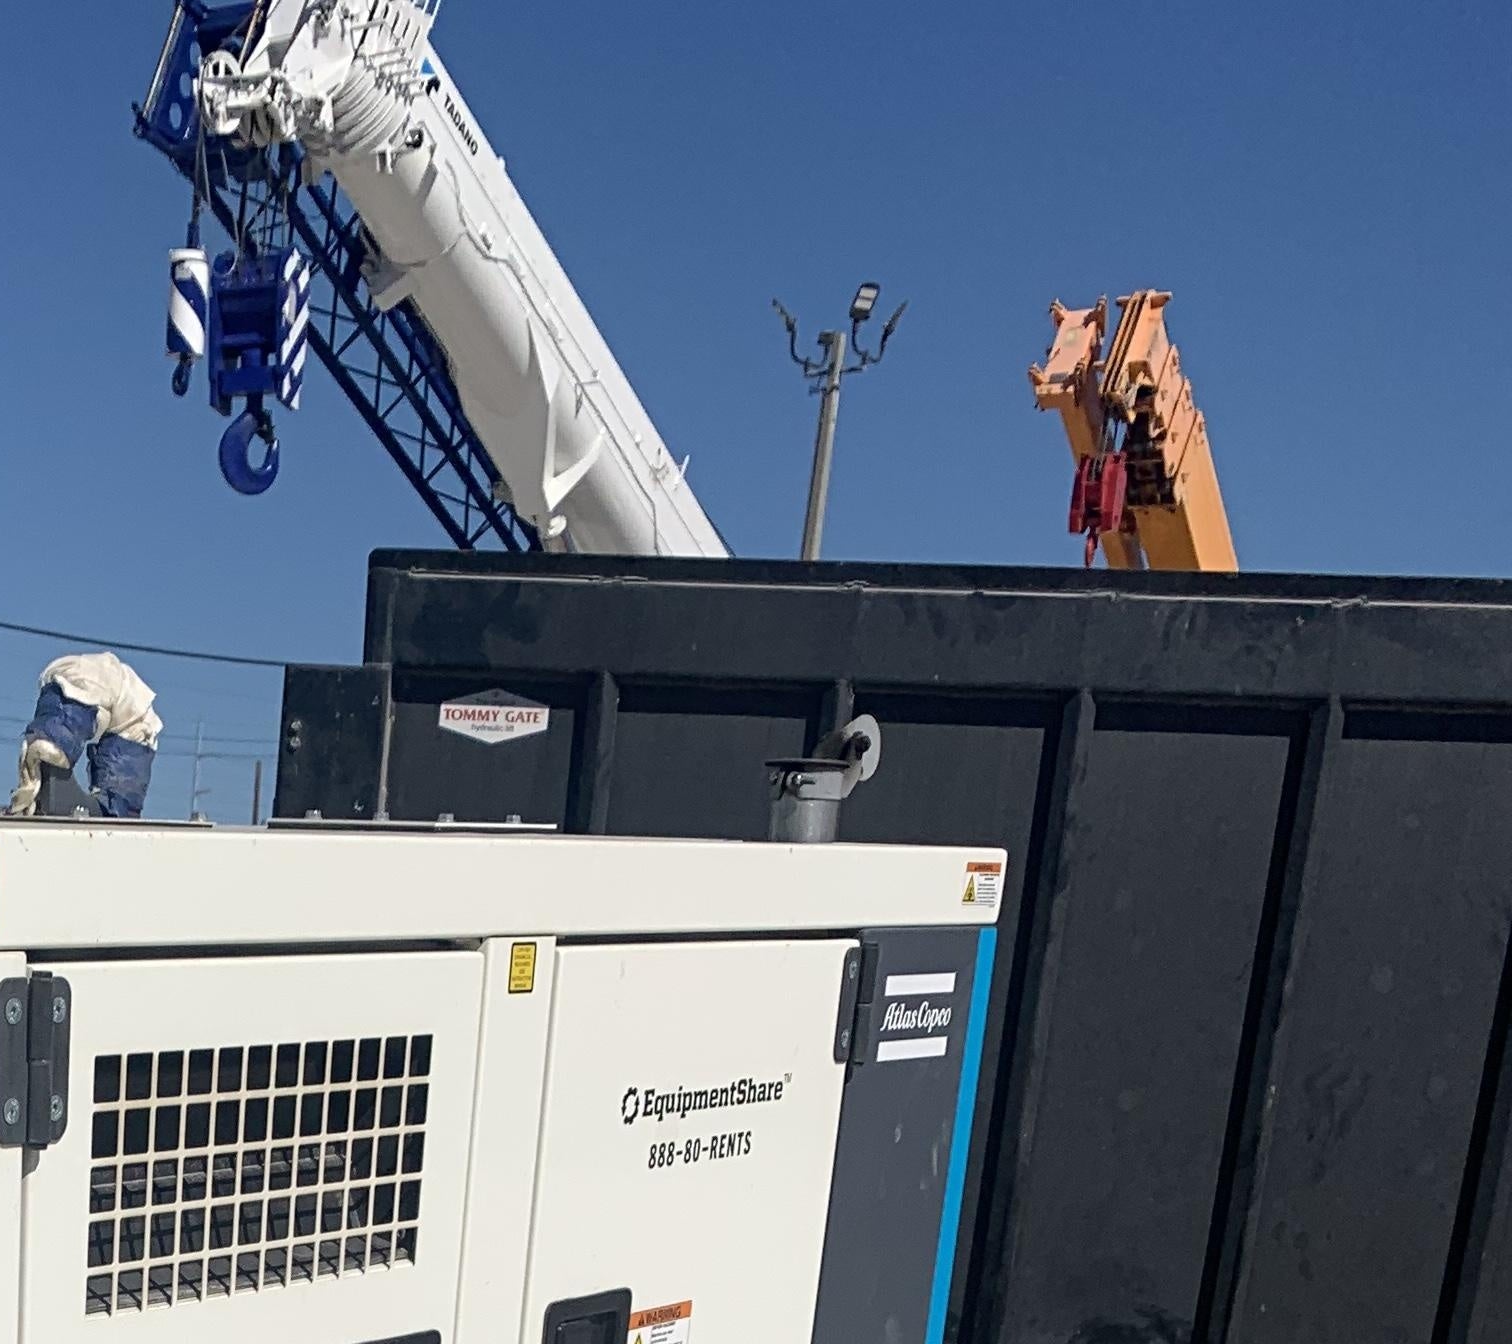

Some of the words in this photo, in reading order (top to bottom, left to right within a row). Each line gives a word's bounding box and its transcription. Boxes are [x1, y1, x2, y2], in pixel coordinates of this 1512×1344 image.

[444, 93, 478, 156] TADANO
[443, 708, 500, 722] TOMMY
[505, 711, 541, 724] GATE
[648, 1130, 752, 1169] 888-80-RENTS
[646, 1305, 682, 1325] WARNING
